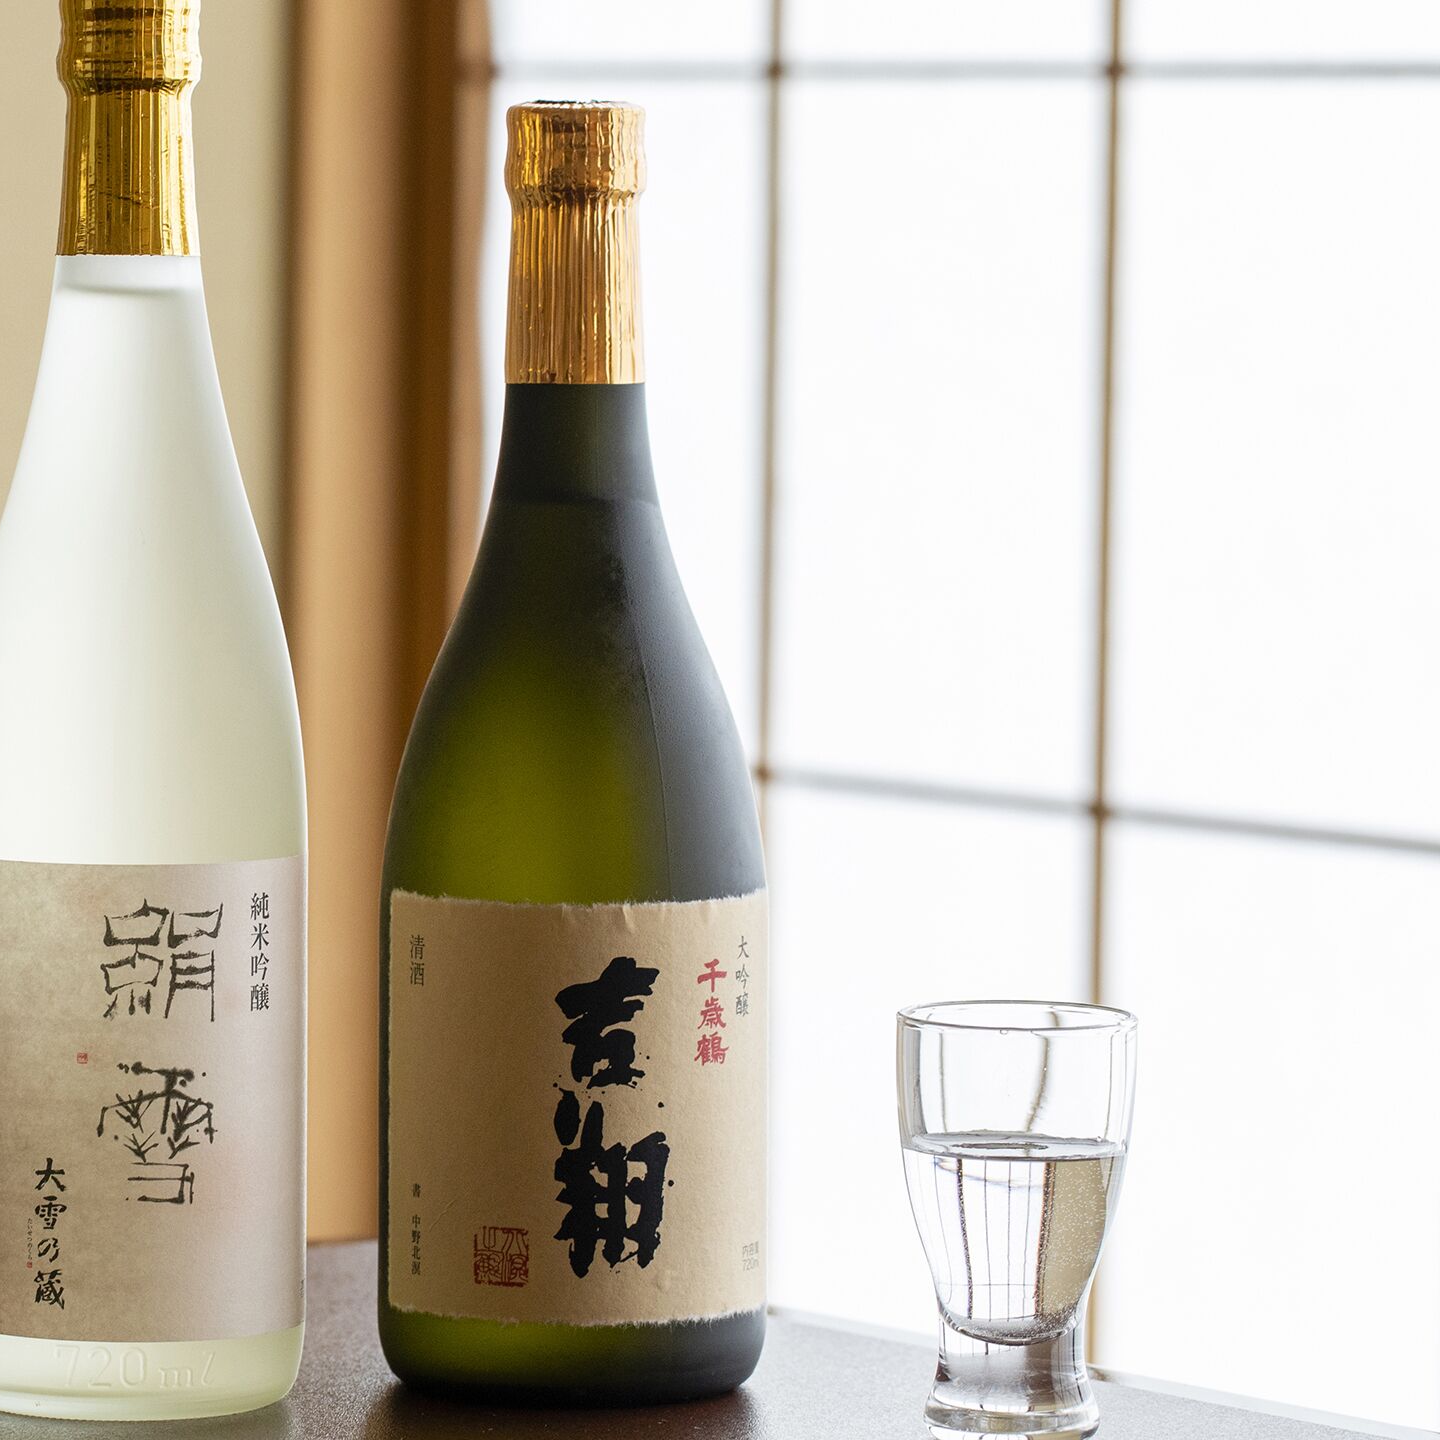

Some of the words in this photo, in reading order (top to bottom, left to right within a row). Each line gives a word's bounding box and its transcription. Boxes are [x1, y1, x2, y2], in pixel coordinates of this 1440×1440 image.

[250, 891, 270, 1012] 純米吟醸
[409, 934, 426, 987] 清酒
[735, 935, 750, 1017] 大吟醸
[693, 958, 730, 1066] 千歳鶴
